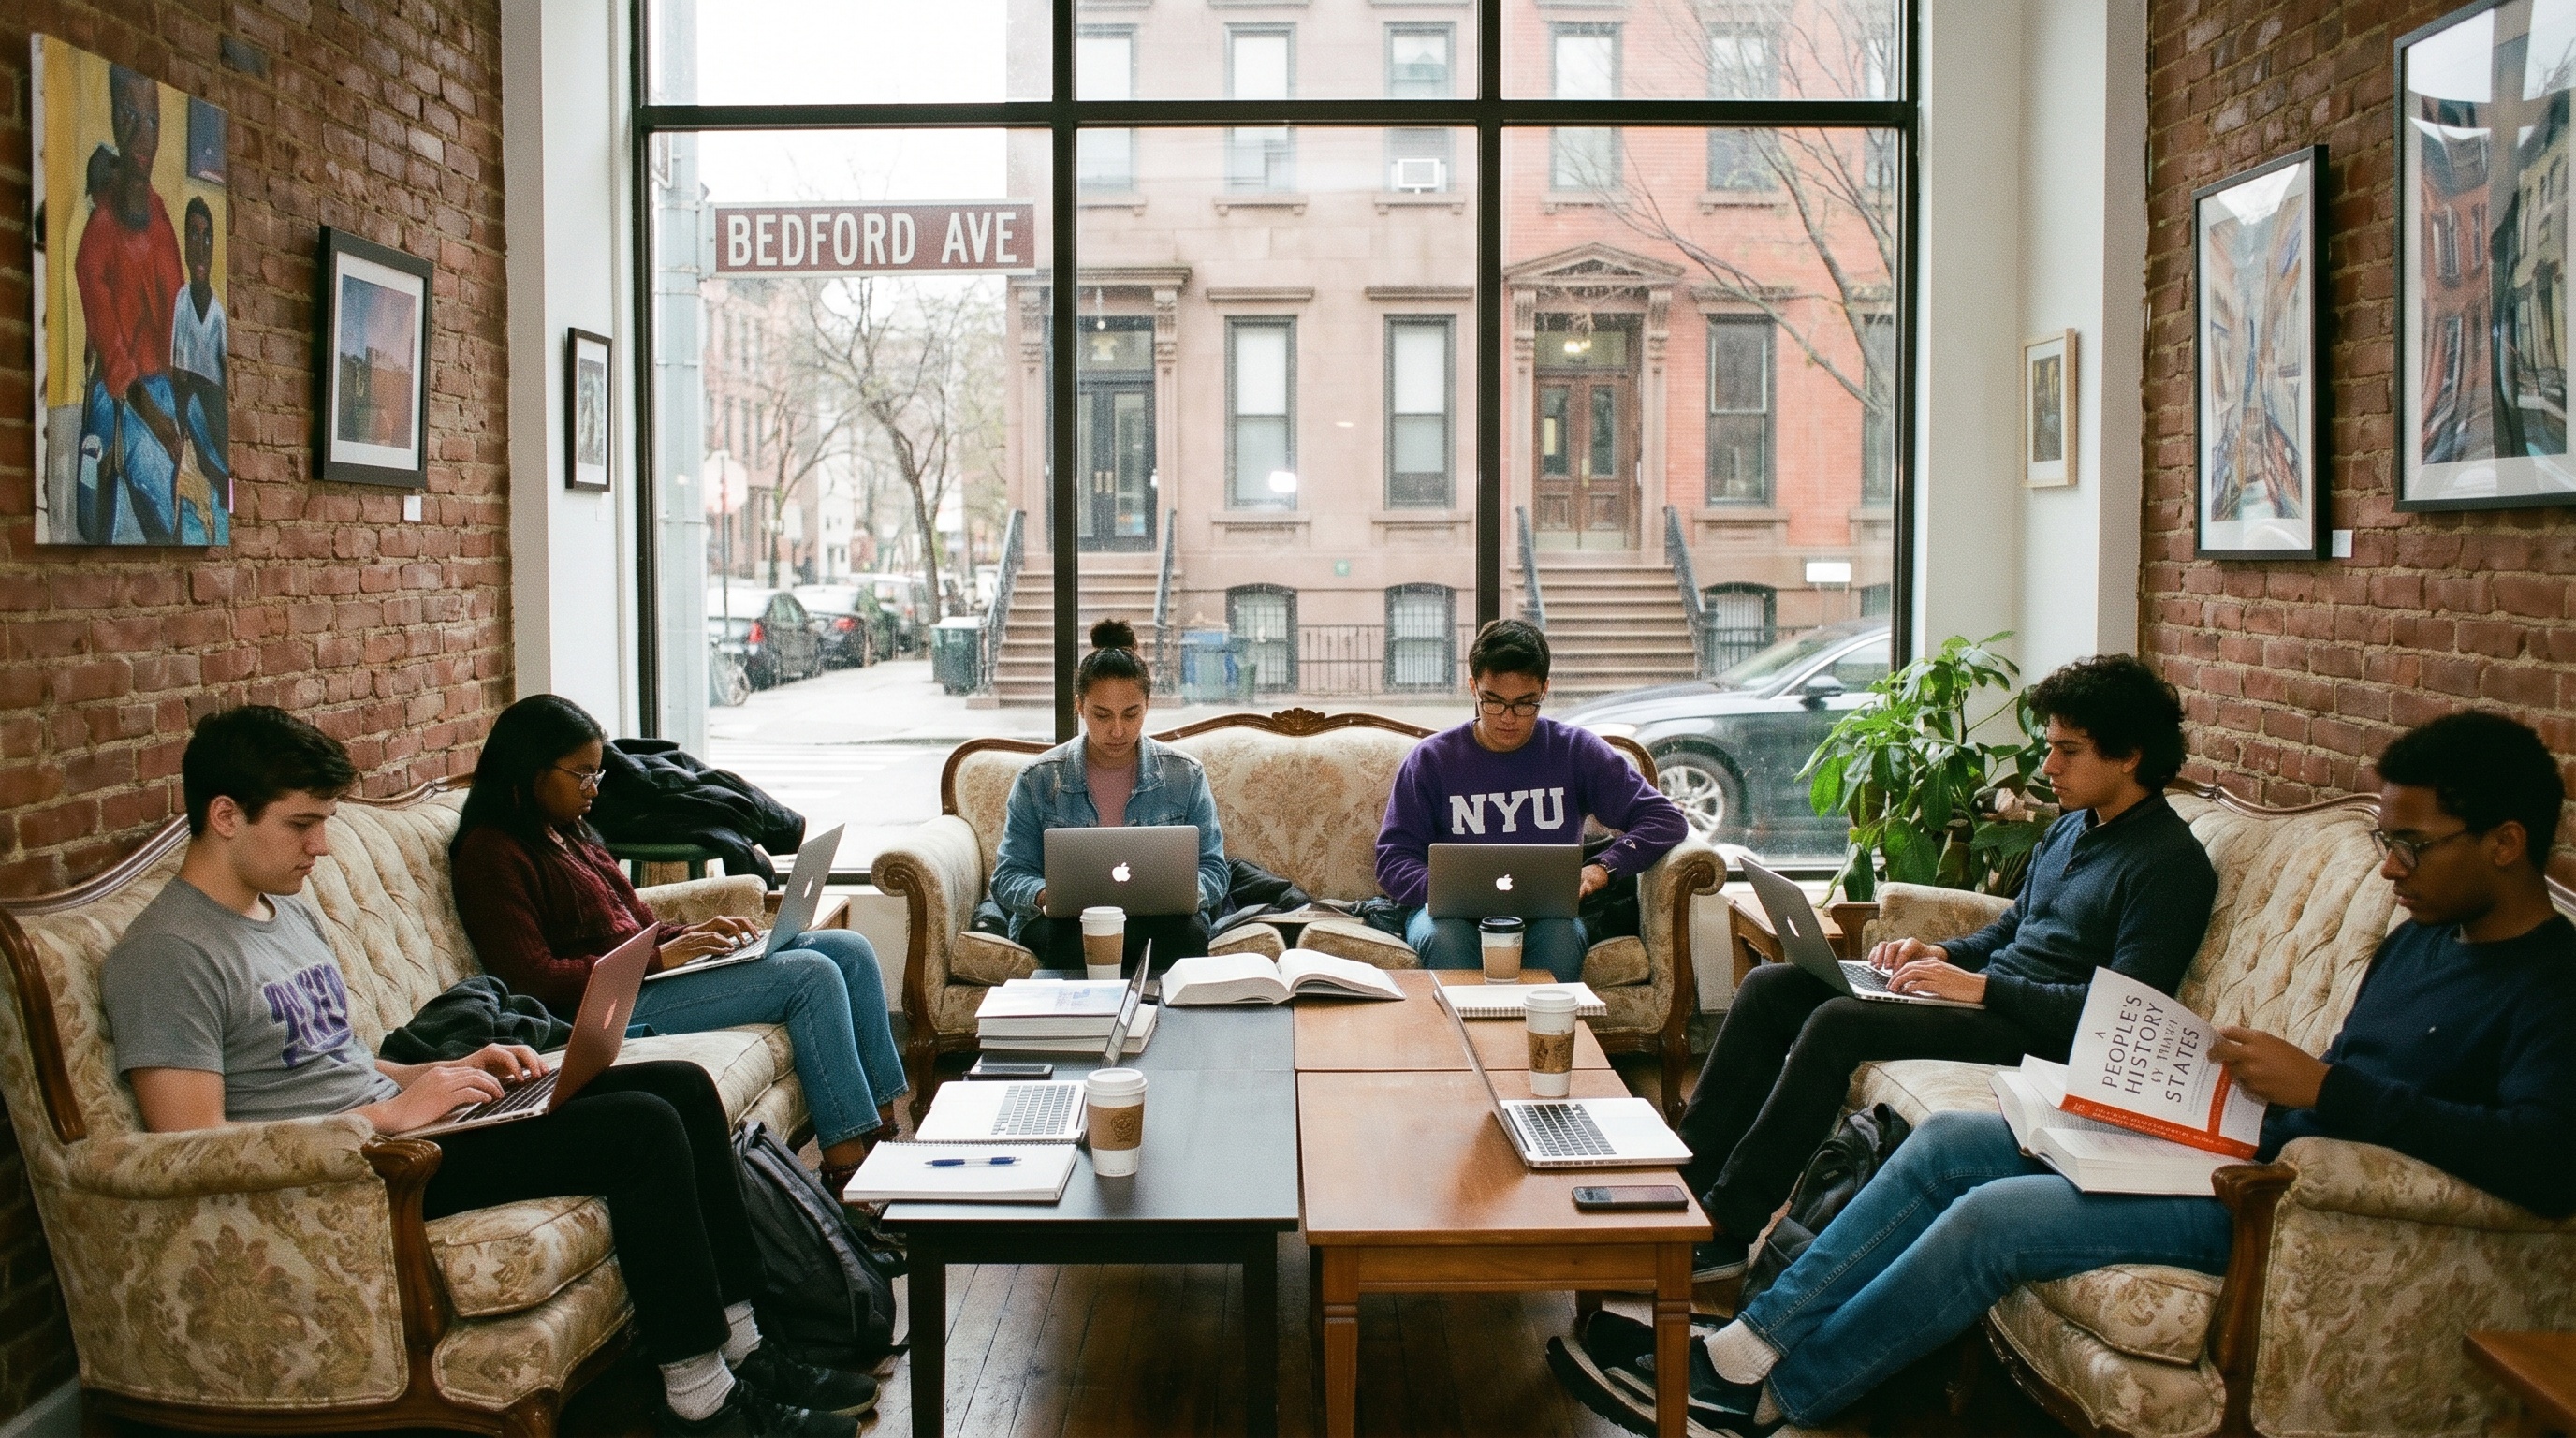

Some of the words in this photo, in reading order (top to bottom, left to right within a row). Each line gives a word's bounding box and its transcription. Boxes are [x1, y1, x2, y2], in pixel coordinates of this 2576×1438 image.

[727, 213, 916, 267] BEDFORD
[941, 212, 1017, 264] AVE
[1449, 787, 1565, 835] NYU
[2101, 994, 2143, 1089] PEOPLE'S
[2124, 1002, 2164, 1095] HISTORY
[2164, 1027, 2200, 1104] STATES
